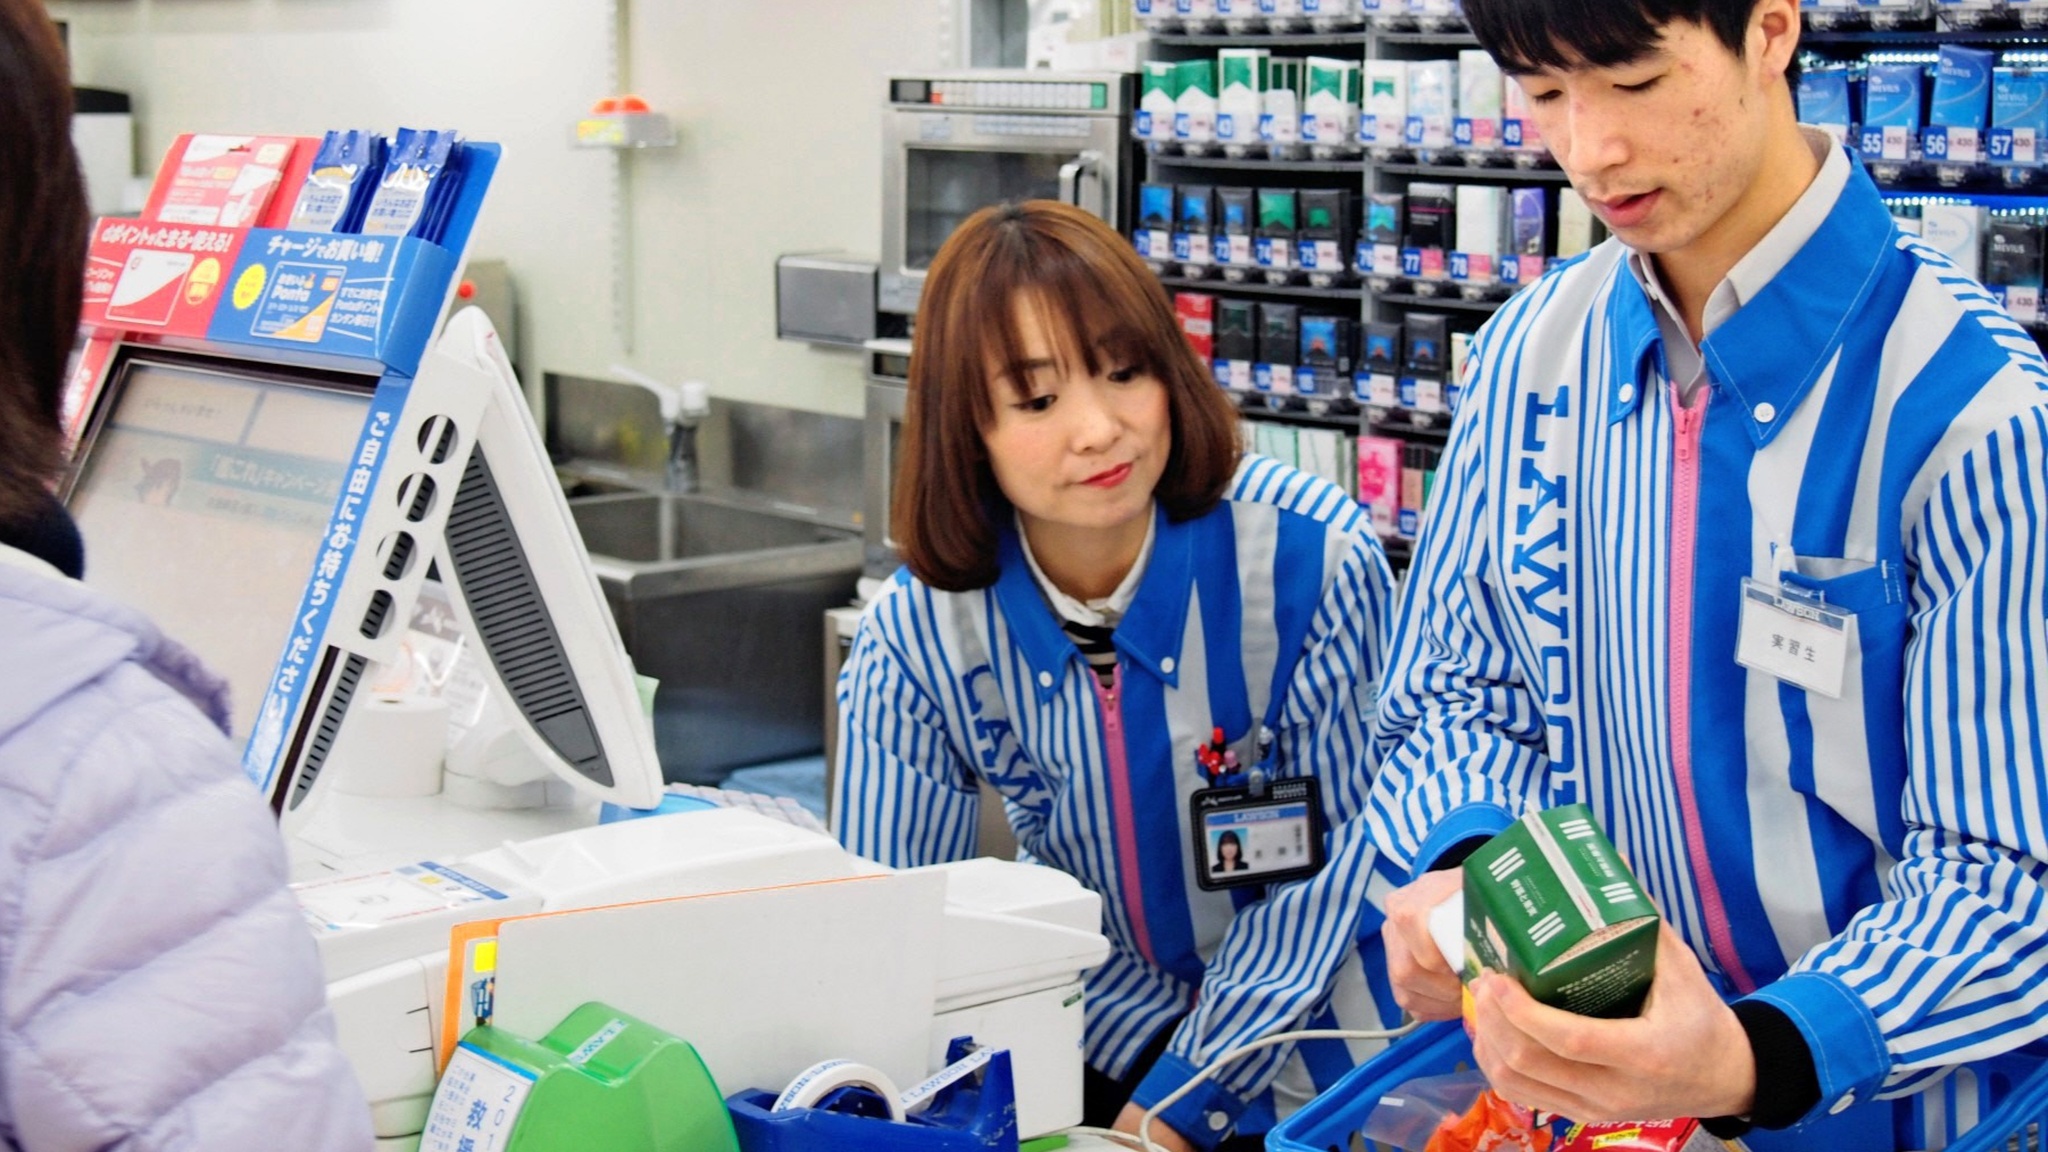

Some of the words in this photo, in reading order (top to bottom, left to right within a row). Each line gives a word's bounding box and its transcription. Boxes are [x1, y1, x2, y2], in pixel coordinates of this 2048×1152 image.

[1862, 133, 1883, 153] 55
[1926, 134, 1947, 155] 56
[1991, 135, 2012, 155] 57
[1404, 253, 1420, 271] 77
[1452, 256, 1468, 276] 78
[1502, 260, 1518, 279] 79
[270, 284, 311, 303] Ponta
[1234, 809, 1280, 823] LAWSON
